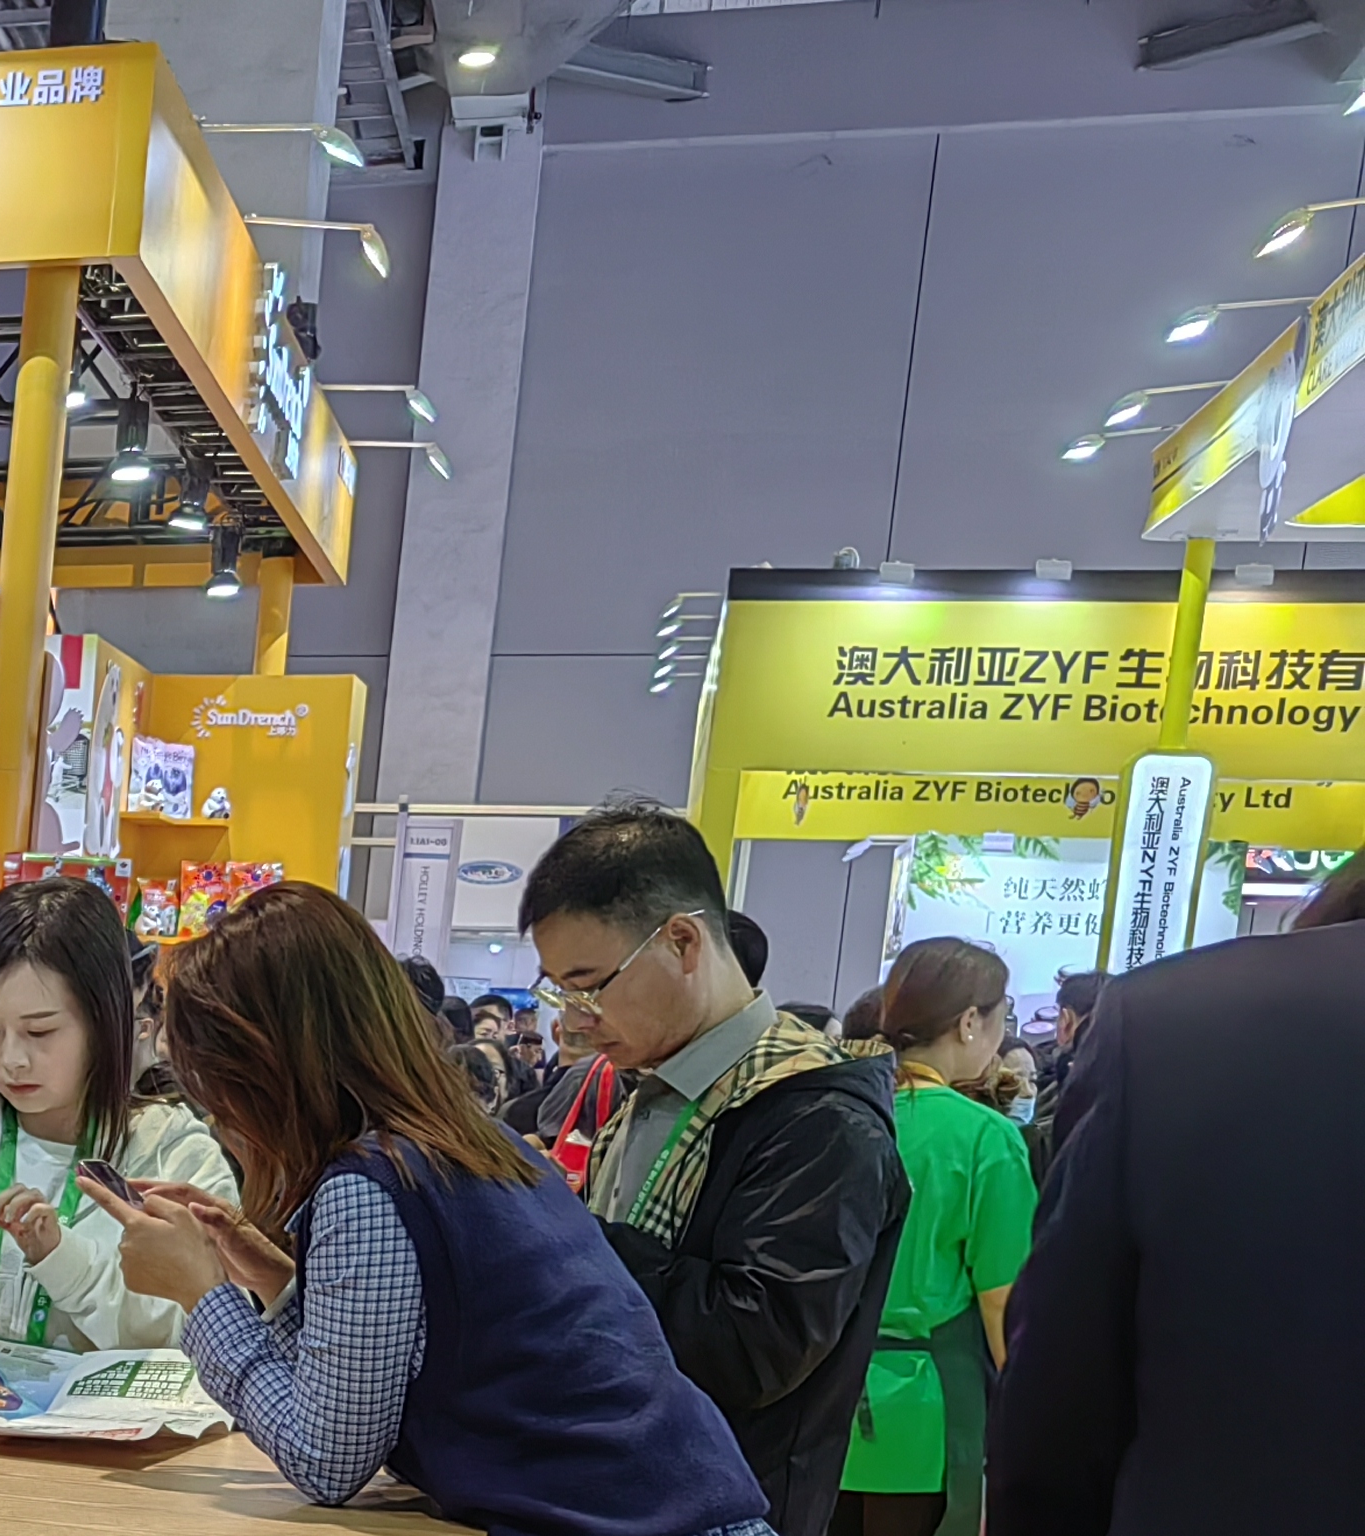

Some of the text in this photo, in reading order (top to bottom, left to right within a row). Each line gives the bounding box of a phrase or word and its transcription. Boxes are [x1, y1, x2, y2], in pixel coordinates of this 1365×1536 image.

[206, 709, 296, 727] SunDrench
[827, 691, 1362, 733] Australia ZYF Biotchnology
[782, 779, 904, 801] Australia
[912, 780, 968, 802] ZYF
[1244, 786, 1293, 809] Ltd
[1171, 776, 1191, 841] Australia
[1166, 846, 1180, 877] ZYF
